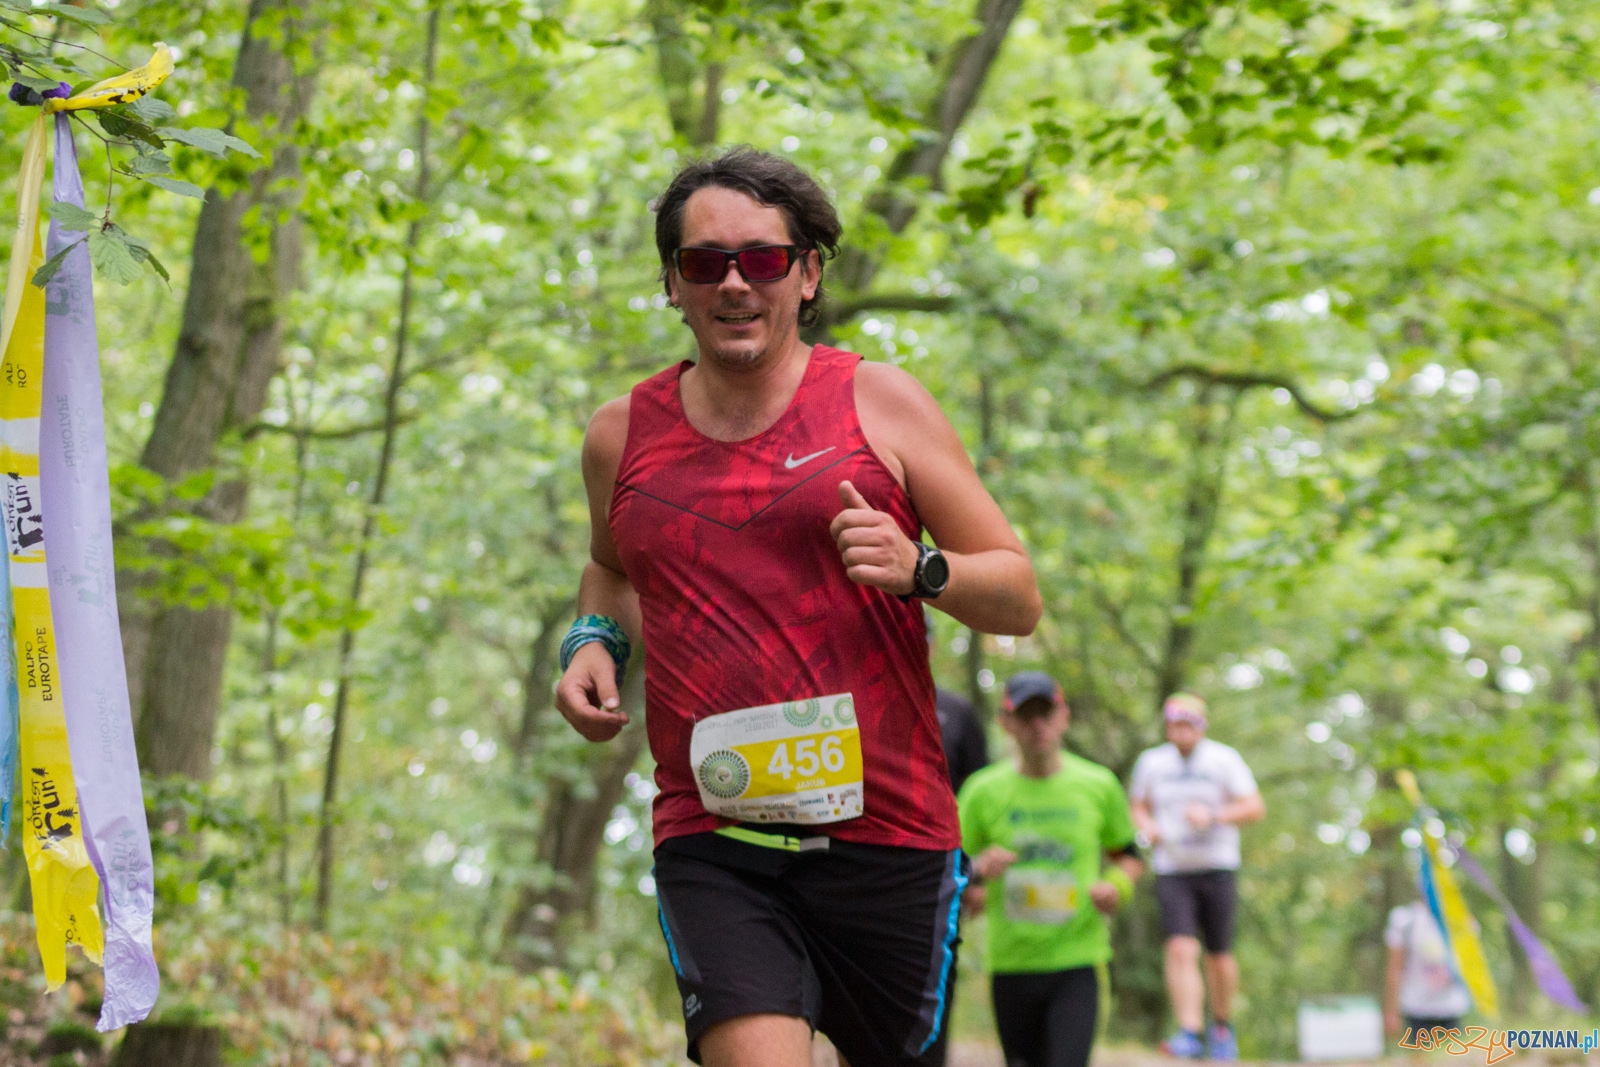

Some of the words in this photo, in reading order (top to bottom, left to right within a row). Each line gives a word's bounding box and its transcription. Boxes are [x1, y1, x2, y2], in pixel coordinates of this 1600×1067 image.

[27, 640, 37, 689] DALPO
[37, 627, 53, 702] EUROTAPE
[767, 735, 845, 780] 456
[795, 776, 826, 790] JAKUB
[31, 779, 47, 841] FOREST
